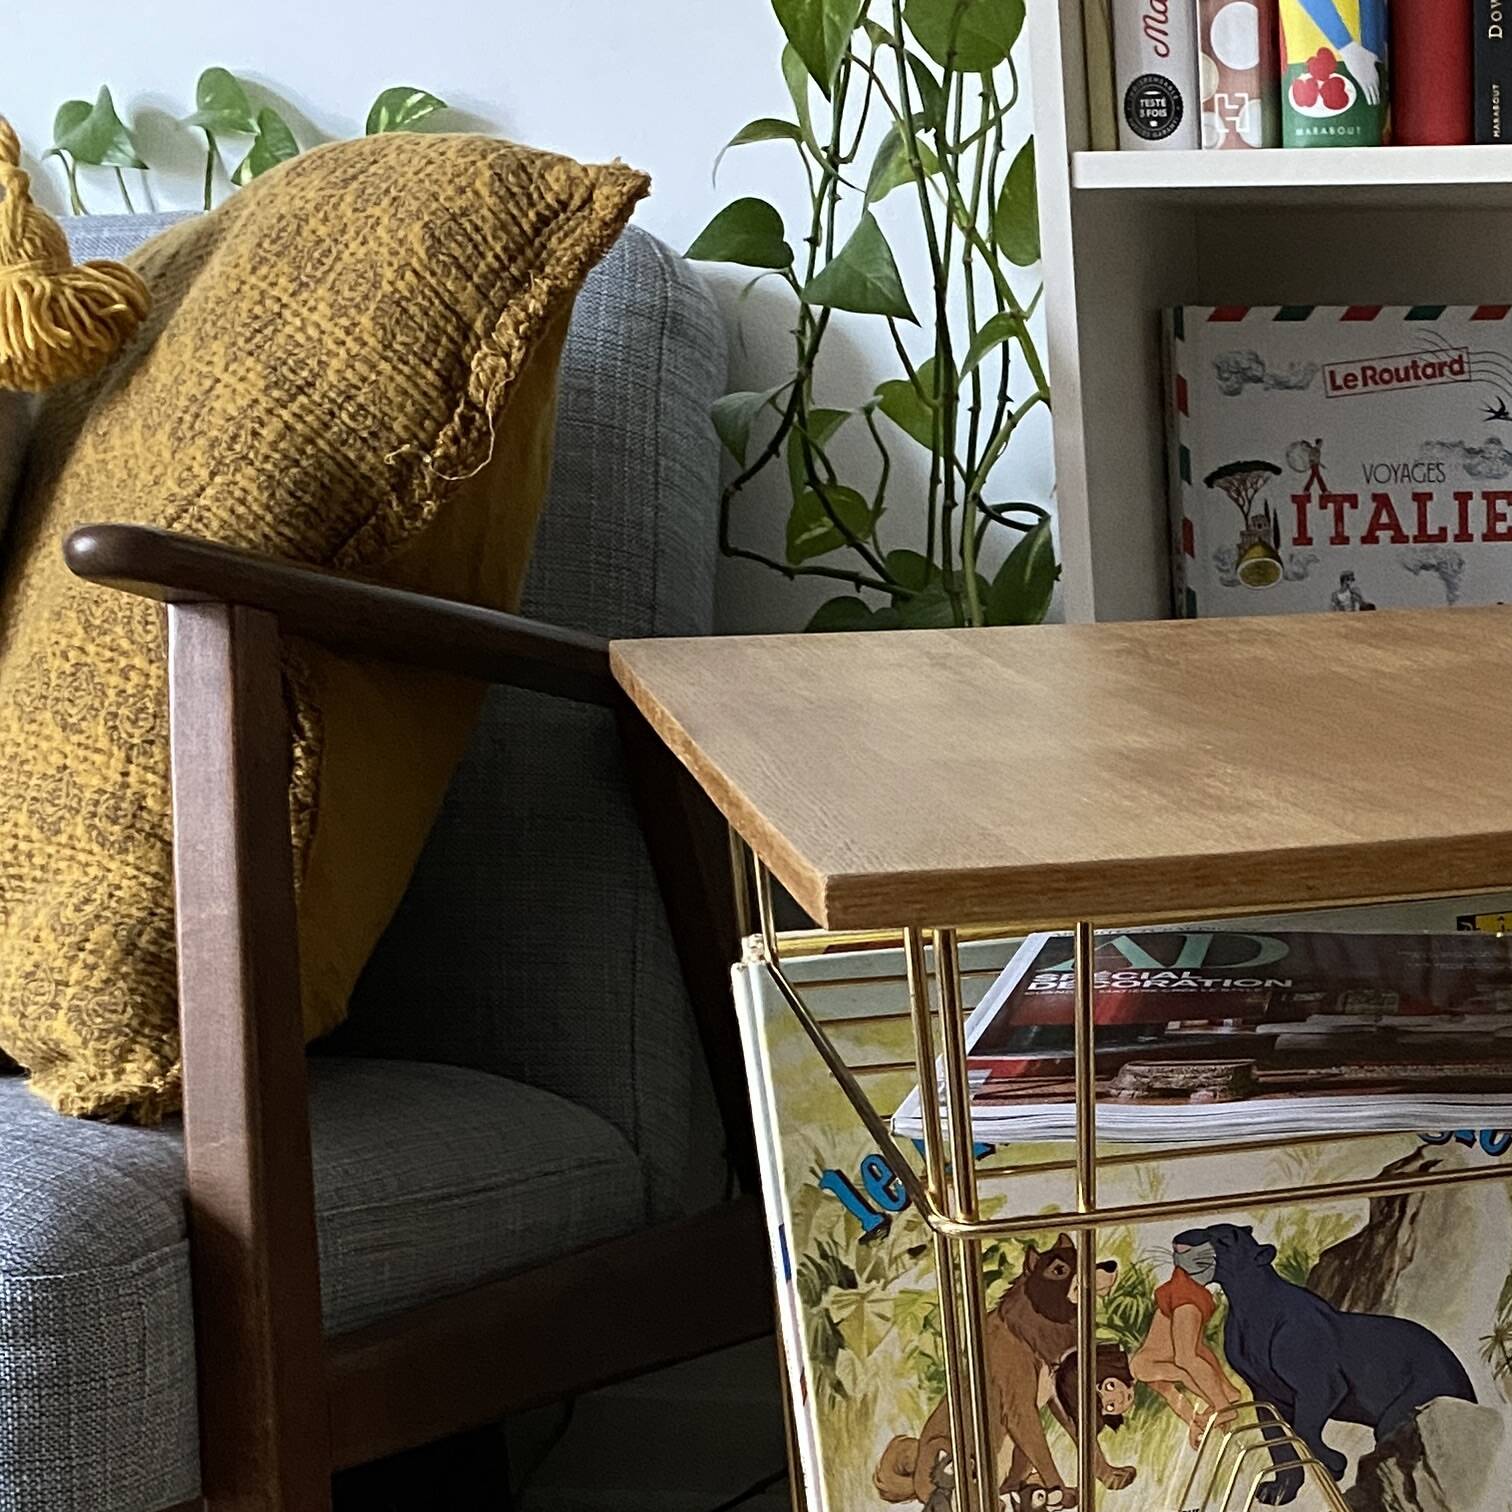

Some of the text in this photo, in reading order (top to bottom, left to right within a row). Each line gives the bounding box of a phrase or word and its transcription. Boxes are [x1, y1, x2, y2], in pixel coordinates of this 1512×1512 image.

[1294, 126, 1362, 137] MARABOUT
[1360, 354, 1466, 387] Routard
[1362, 462, 1447, 485] VOYAGES
